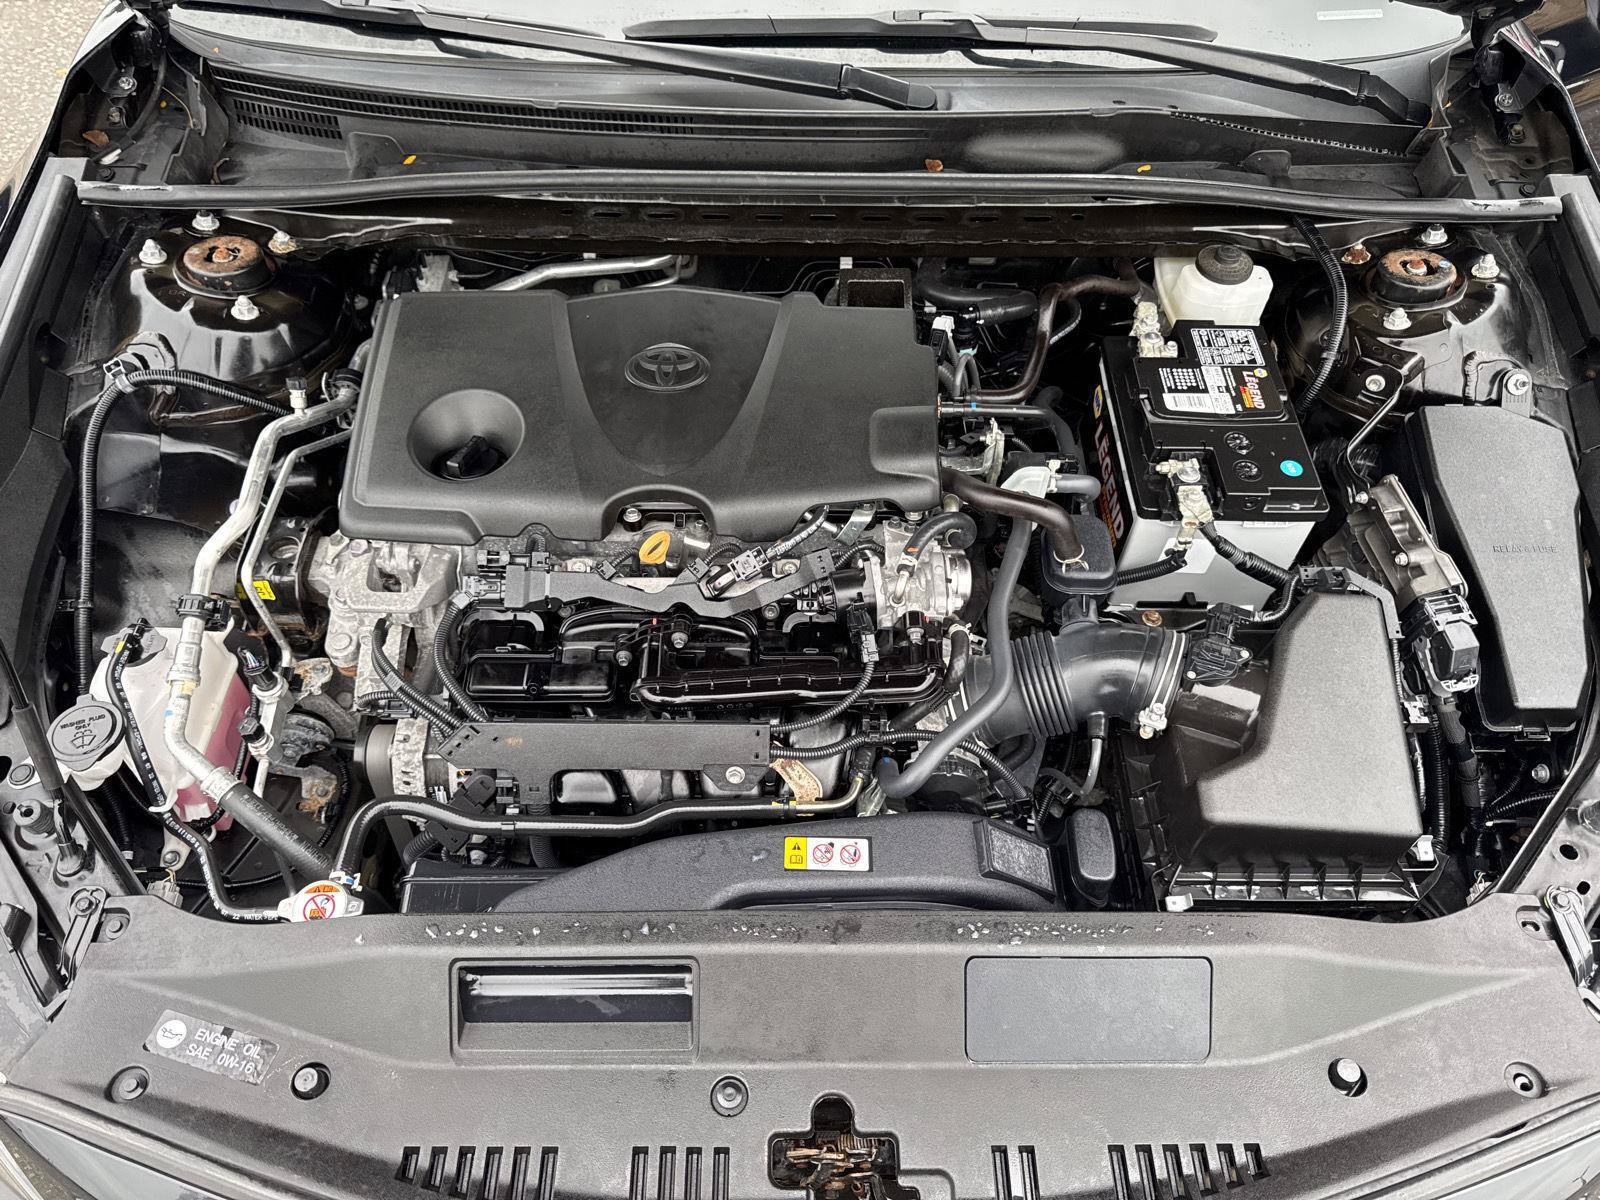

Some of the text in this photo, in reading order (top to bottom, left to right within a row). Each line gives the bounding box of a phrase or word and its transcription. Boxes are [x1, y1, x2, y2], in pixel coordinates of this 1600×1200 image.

[1492, 545, 1522, 553] RELAY
[1532, 545, 1557, 553] FUSE
[61, 714, 106, 729] WASHER FLUID
[194, 1028, 261, 1059] ENGINE OIL
[186, 1043, 255, 1074] SAE 0W-16
